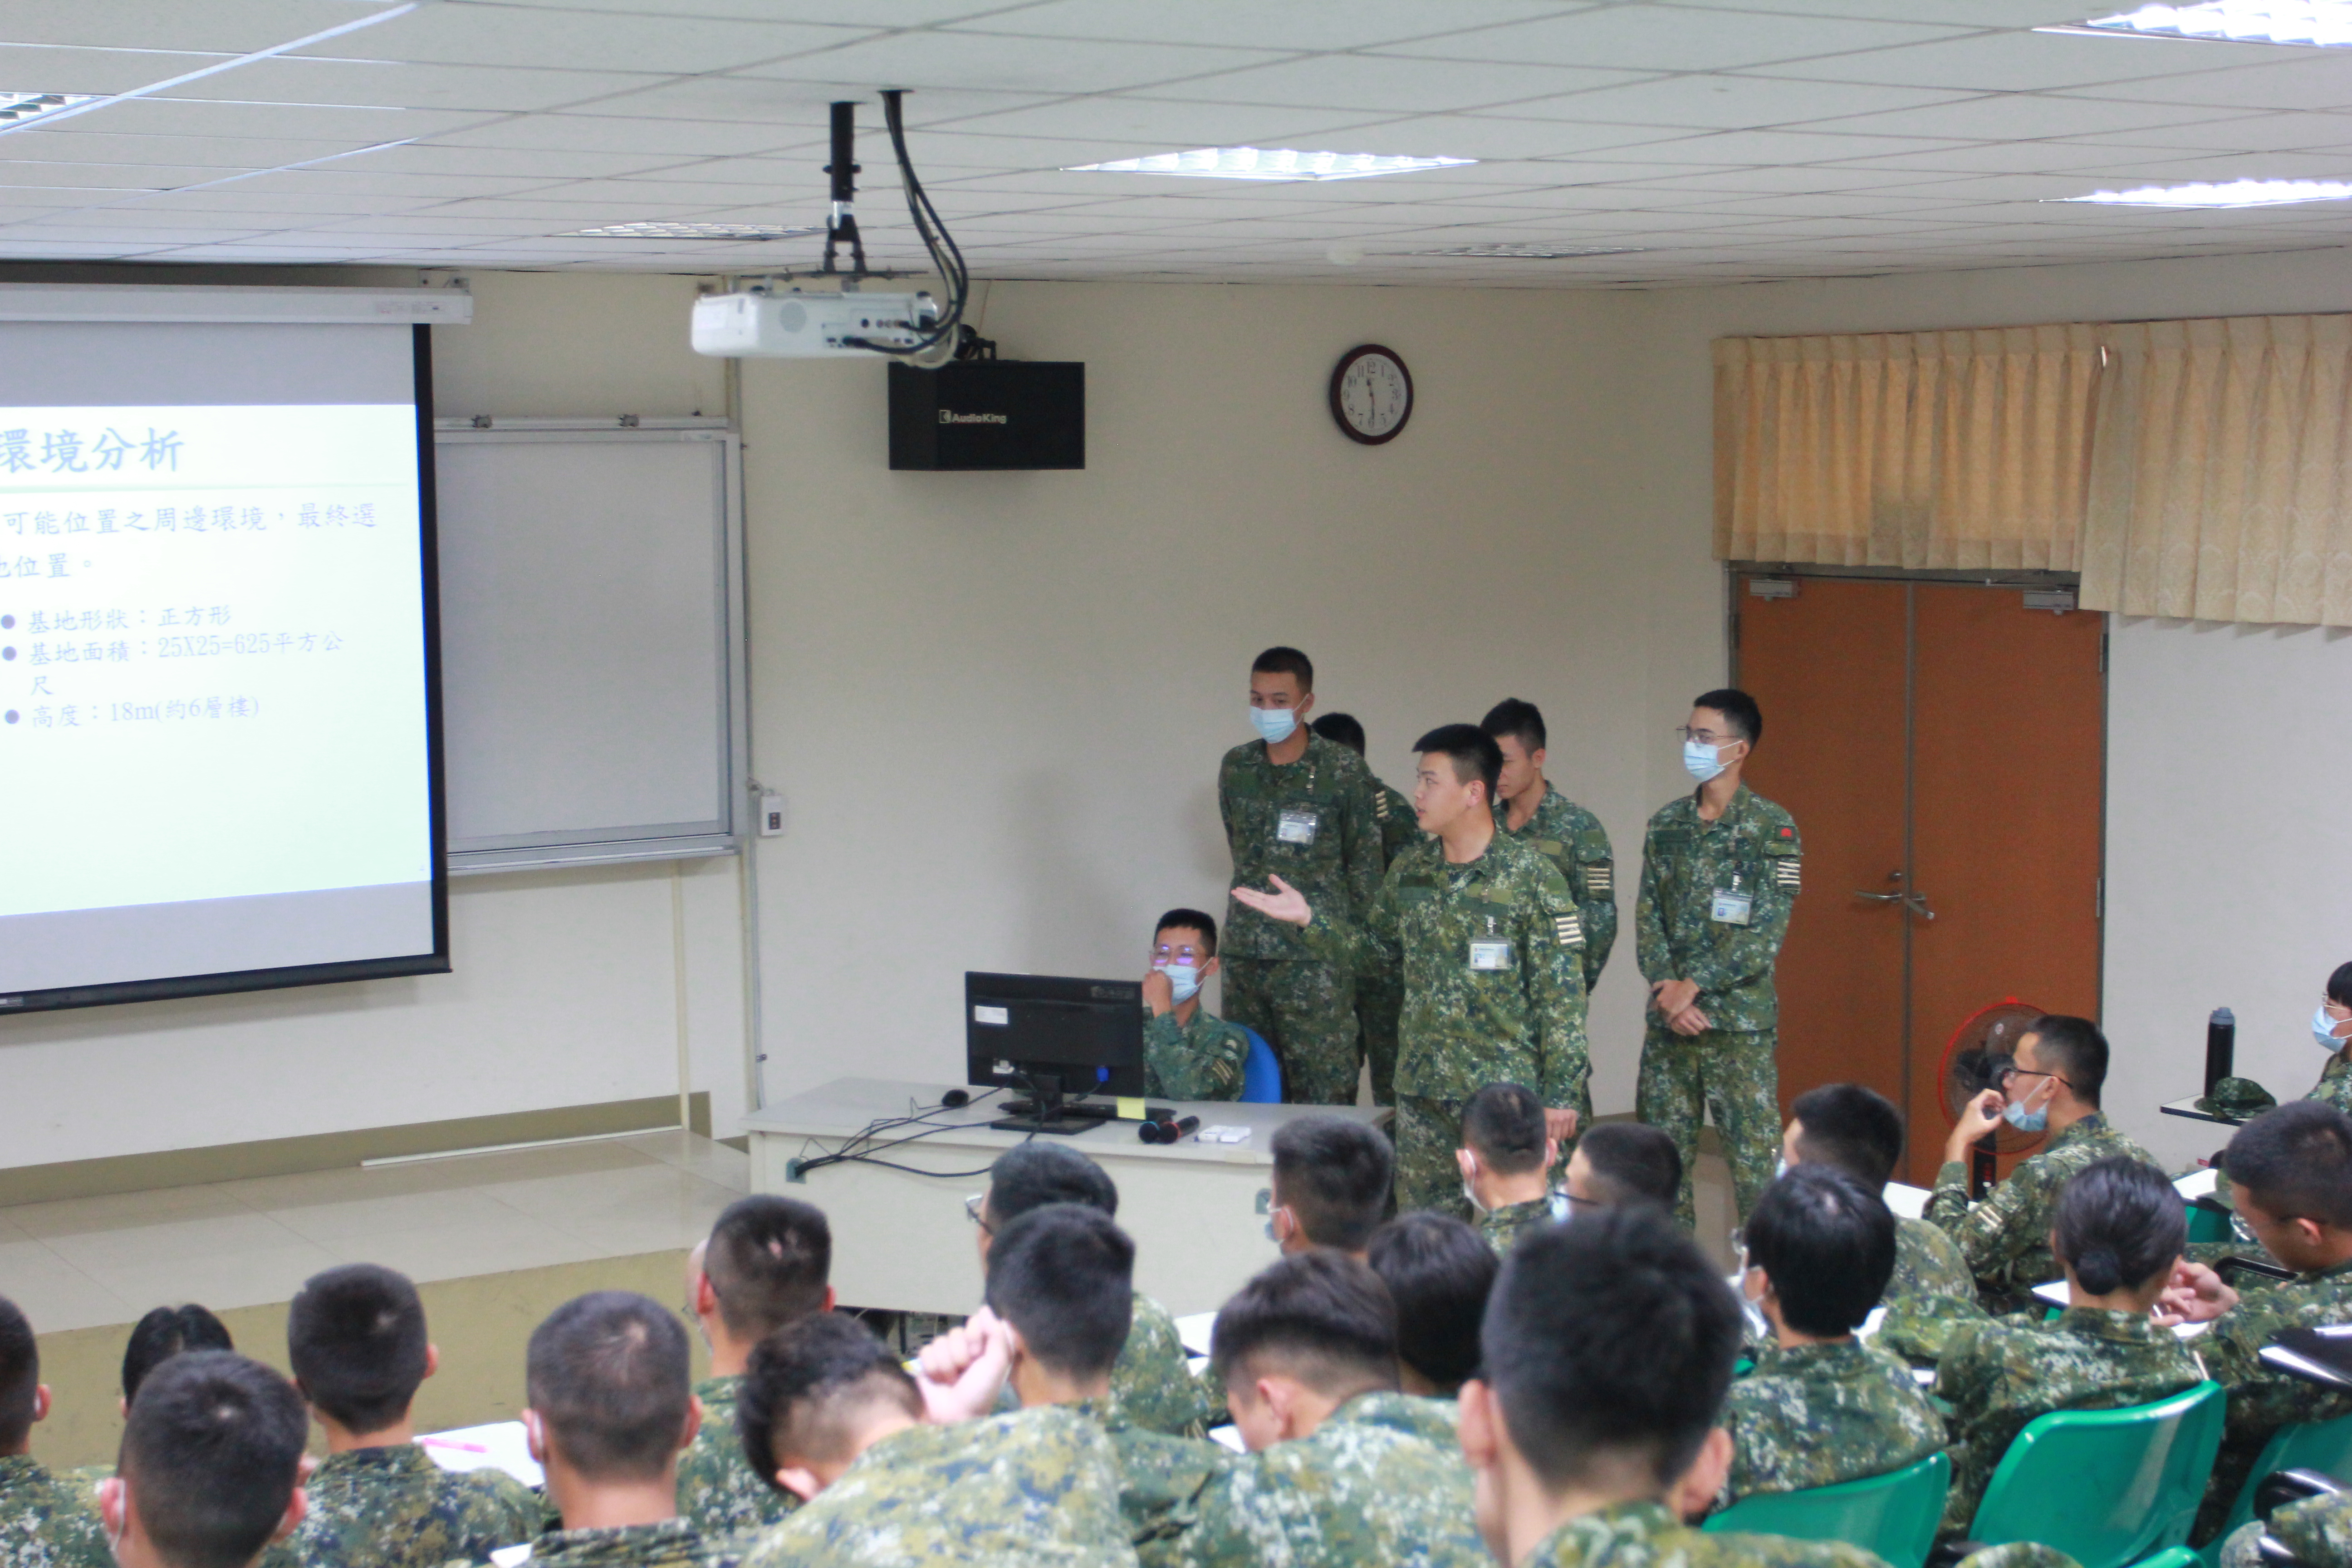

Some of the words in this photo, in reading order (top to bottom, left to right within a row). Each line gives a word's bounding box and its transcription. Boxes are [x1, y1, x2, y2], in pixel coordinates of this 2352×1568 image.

[1357, 365, 1364, 377] 11
[1348, 404, 1355, 416] 8
[952, 413, 1007, 424] AudioKing
[0, 426, 186, 474] 環境分析
[30, 675, 54, 696] 尺
